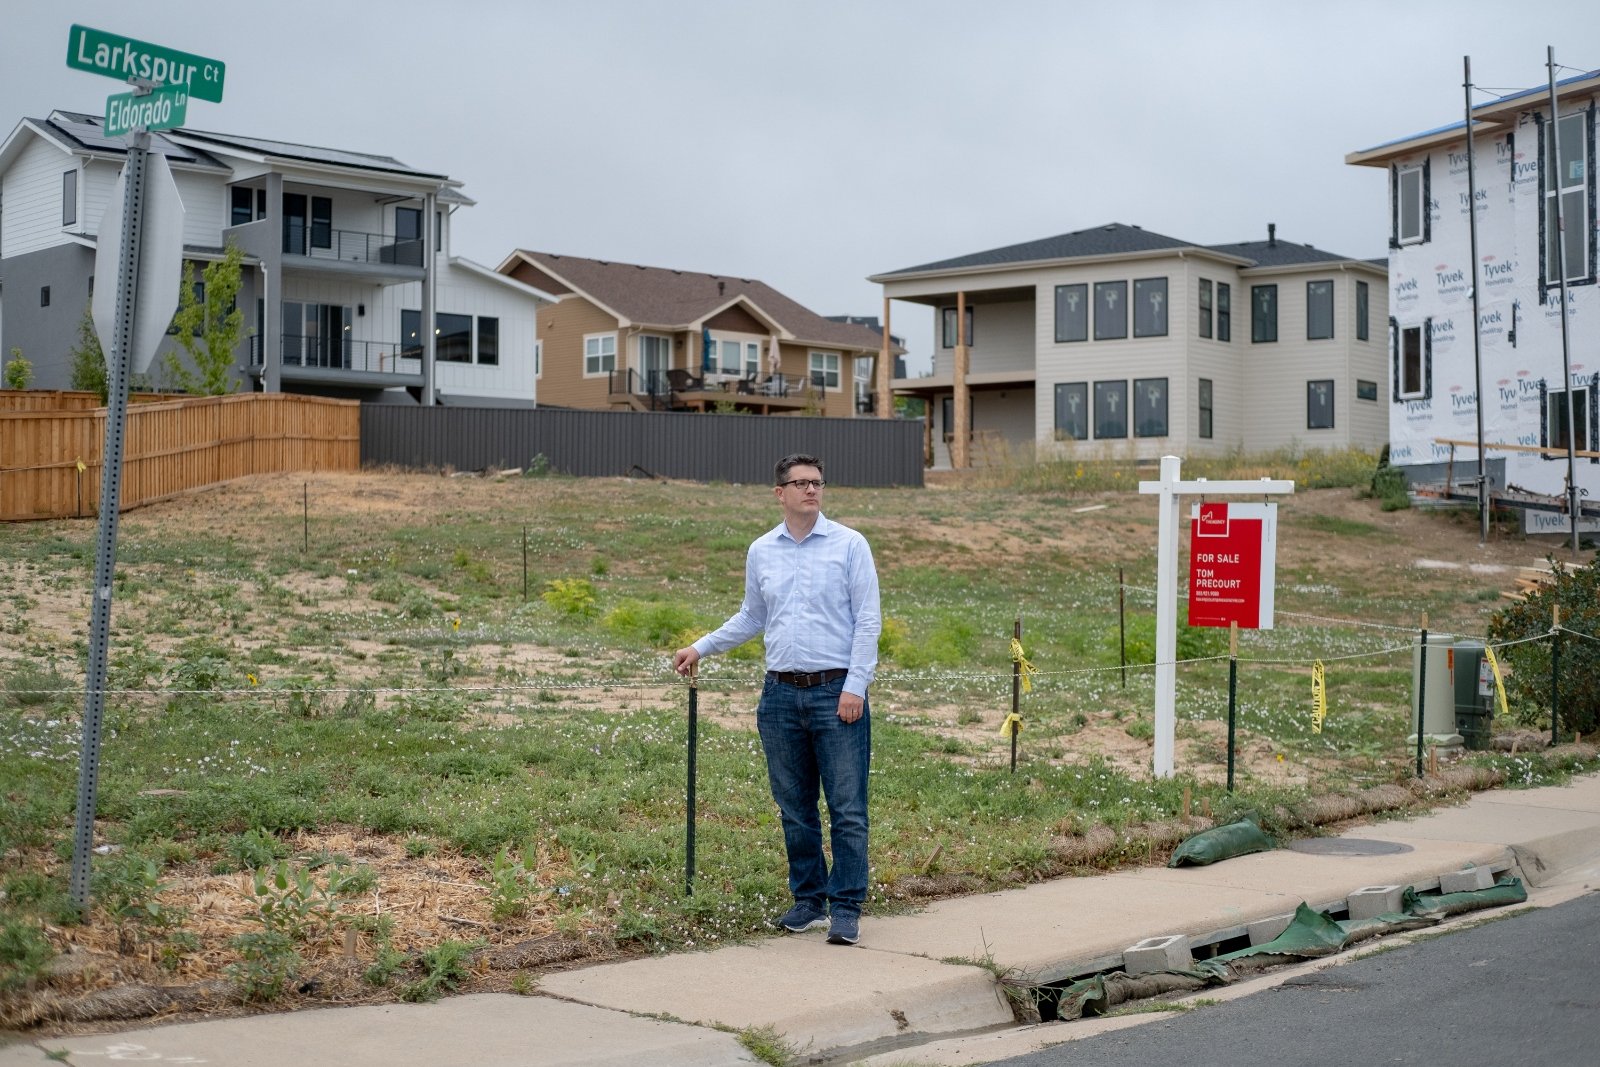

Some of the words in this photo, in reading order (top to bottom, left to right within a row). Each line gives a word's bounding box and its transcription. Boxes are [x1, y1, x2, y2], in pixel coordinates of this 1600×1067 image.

[77, 30, 197, 85] Larkspur
[203, 64, 220, 82] Ct
[108, 94, 171, 131] Eldorado
[175, 91, 186, 106] Ln
[1514, 161, 1537, 177] Tyve
[1459, 189, 1487, 206] Tyek
[1484, 260, 1512, 278] Tyvek
[1395, 277, 1418, 294] yvek
[1436, 269, 1464, 287] Tyvek
[1431, 319, 1454, 335] yvek
[1480, 310, 1502, 328] yvek
[1499, 387, 1516, 402] Tyv
[1517, 432, 1537, 446] vek
[1391, 445, 1413, 459] yvek
[1533, 513, 1565, 530] Tyvek
[1197, 553, 1214, 563] FOR
[1217, 553, 1240, 564] SALE
[1196, 568, 1214, 578] TOM
[1196, 578, 1241, 589] PRECOURT
